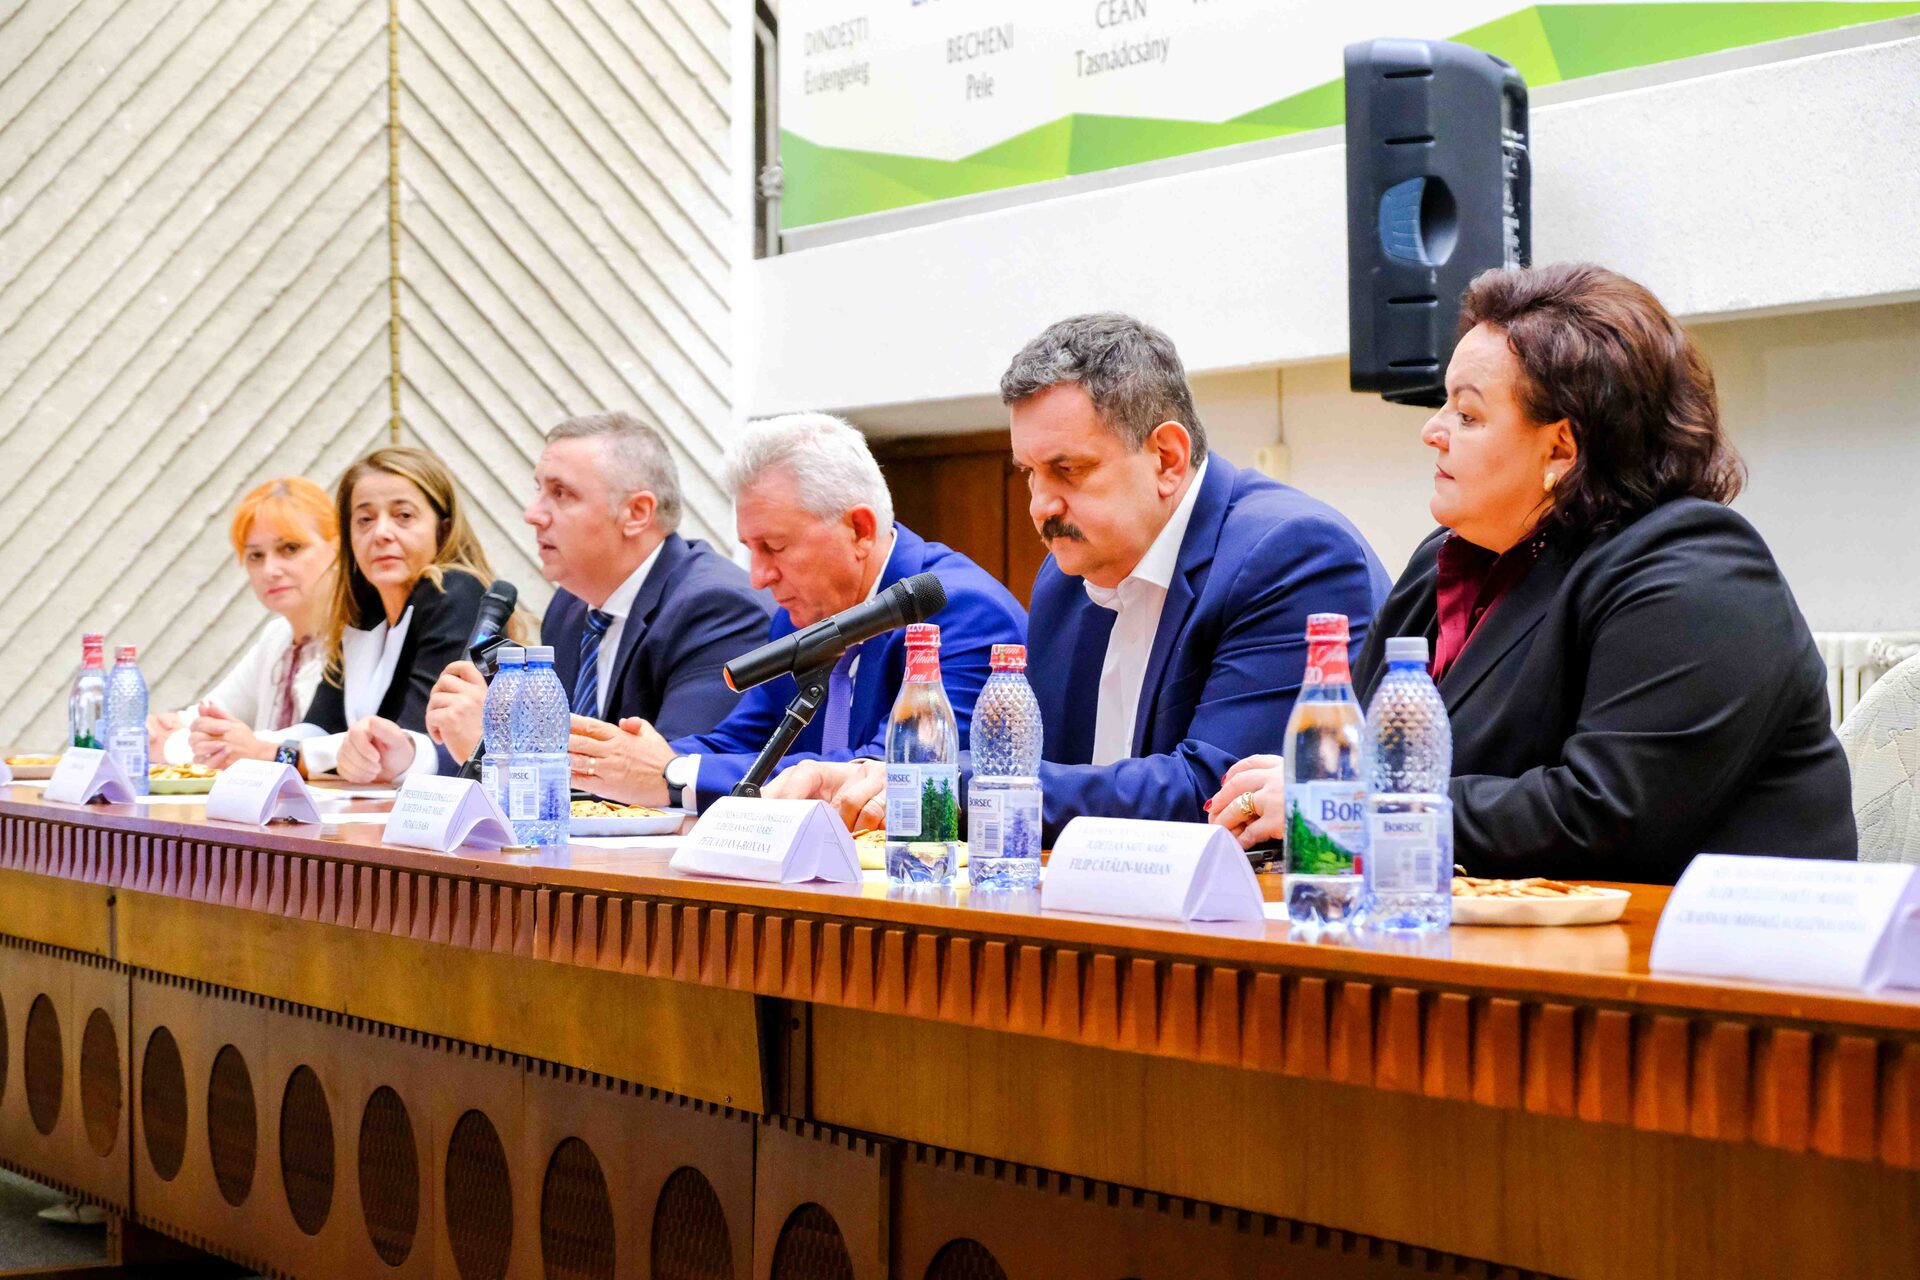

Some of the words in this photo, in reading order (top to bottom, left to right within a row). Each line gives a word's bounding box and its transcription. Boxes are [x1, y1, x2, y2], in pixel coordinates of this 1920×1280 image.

[946, 23, 1015, 64] BECHENI
[965, 72, 996, 101] Pele
[1321, 799, 1363, 821] BOR
